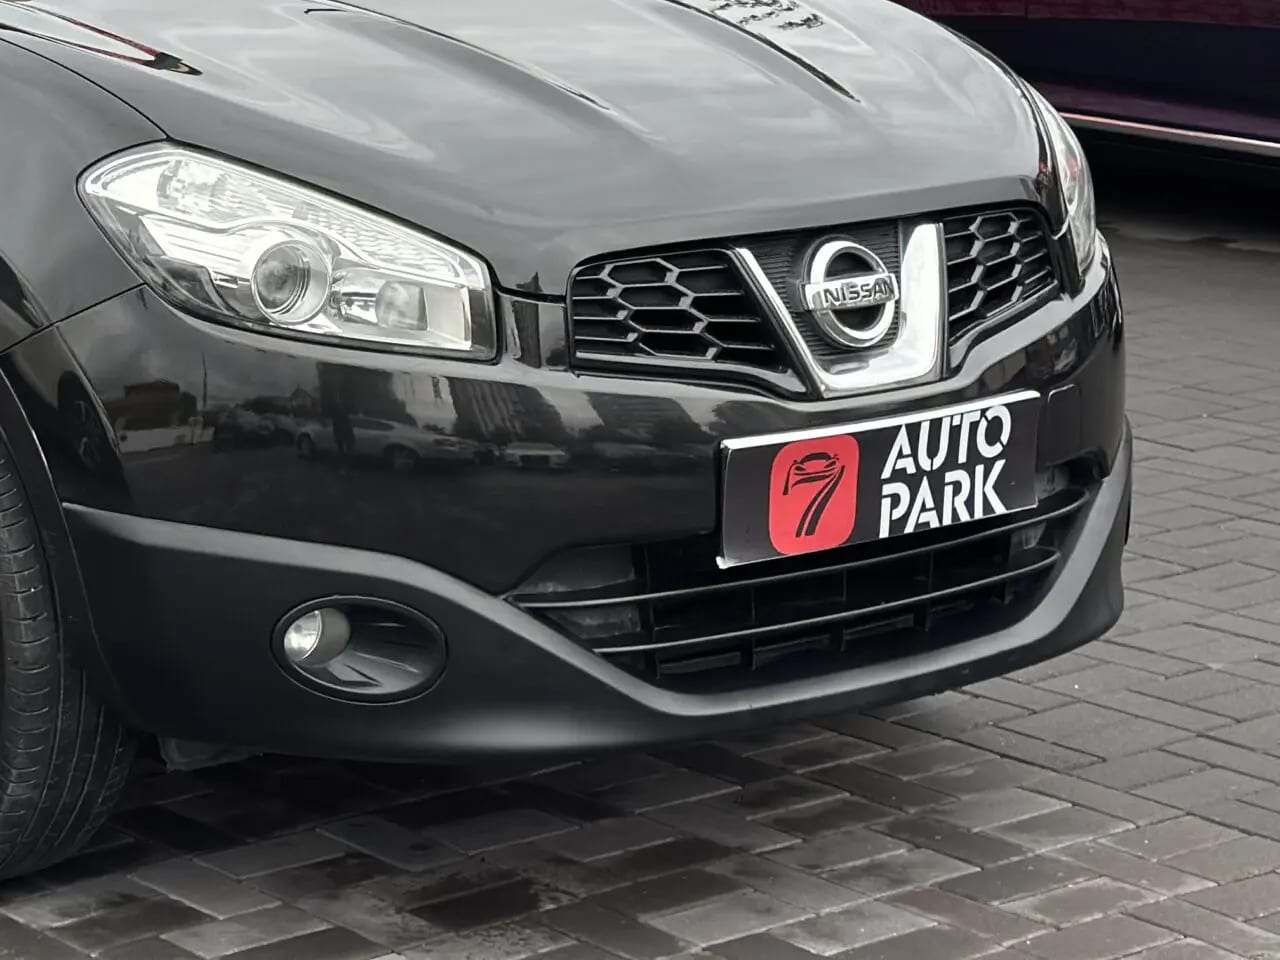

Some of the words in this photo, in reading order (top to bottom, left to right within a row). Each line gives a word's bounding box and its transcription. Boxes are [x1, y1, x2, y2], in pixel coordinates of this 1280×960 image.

[823, 277, 895, 303] NISSAN
[880, 404, 1013, 480] AUTO
[878, 459, 1008, 539] PARK
